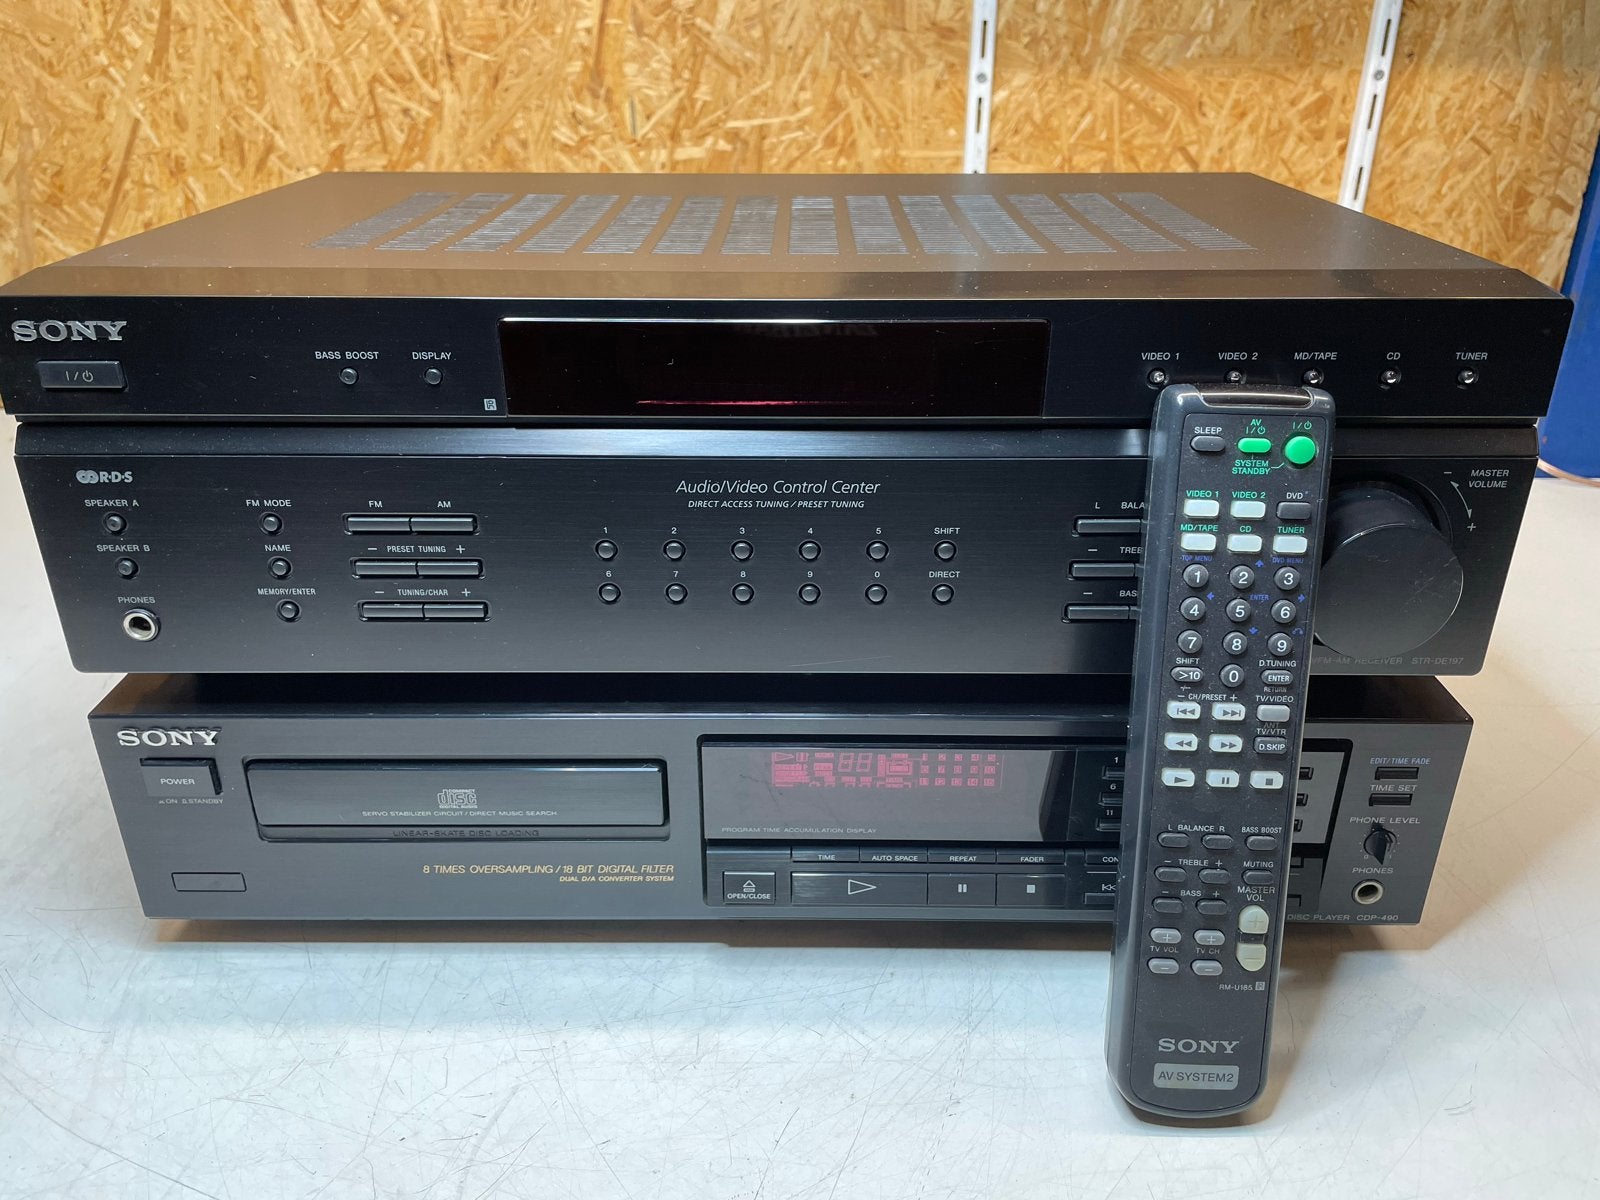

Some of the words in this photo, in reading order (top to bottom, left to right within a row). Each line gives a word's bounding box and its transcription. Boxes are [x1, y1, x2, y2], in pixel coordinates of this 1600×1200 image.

[11, 320, 127, 342] SONY
[315, 351, 341, 360] BASS
[345, 351, 379, 360] BOOST
[412, 352, 452, 360] DISPLAY
[1141, 352, 1171, 361] VIDEO
[1175, 352, 1180, 360] 1
[1218, 352, 1248, 361] VIDEO
[1251, 352, 1258, 360] 2
[1294, 352, 1338, 361] MD/TAPE
[1386, 352, 1401, 360] CD
[1455, 352, 1488, 360] TUNER
[1470, 469, 1509, 477] MASTER
[675, 480, 768, 494] Audio/Video
[773, 480, 828, 494] Control
[831, 480, 881, 494] Center
[246, 499, 260, 507] FM
[264, 499, 292, 507] MODE
[368, 500, 383, 508] FM
[437, 500, 452, 508] AM
[688, 500, 719, 508] DIRECT
[721, 500, 753, 508] ACCESS
[755, 500, 789, 508] TUNING
[797, 500, 829, 508] PRESET
[830, 500, 865, 508] TUNING
[934, 527, 960, 535] SHIFT
[1180, 524, 1219, 532] MD/TAPE
[264, 544, 292, 552] NAME
[386, 545, 415, 553] PRESET
[418, 545, 447, 553] TUNING
[605, 570, 612, 578] 6
[673, 570, 679, 578] 7
[740, 570, 746, 578] 8
[807, 570, 813, 578] 9
[874, 570, 880, 578] 0
[928, 570, 960, 578] DIRECT
[1194, 571, 1201, 583] 1
[1238, 571, 1249, 584] 2
[1283, 572, 1294, 585] 3
[117, 596, 156, 604] PHONES
[1189, 604, 1200, 616] 4
[1235, 605, 1245, 618] 5
[1280, 606, 1291, 619] 6
[1187, 637, 1197, 649] 7
[1231, 638, 1242, 651] 8
[1277, 640, 1287, 652] 9
[1411, 657, 1464, 665] STR-DE197
[1229, 671, 1239, 683] 0
[117, 729, 218, 747] SONY
[1259, 743, 1286, 751] D.SKIP
[1370, 757, 1409, 765] EDIT/TIME
[1411, 757, 1431, 765] FADE
[1177, 824, 1215, 832] BALANCE
[1219, 825, 1226, 833] R
[1261, 826, 1283, 834] BOOST
[423, 865, 430, 873] 8
[434, 865, 466, 873] TIMES
[469, 865, 554, 874] OVERSAMPLING
[577, 865, 594, 873] BIT
[598, 865, 638, 873] DIGITAL
[641, 864, 674, 873] FILTER
[1237, 886, 1275, 894] MASTER
[1246, 894, 1265, 902] VOL
[1158, 1038, 1240, 1054] SONY
[1158, 1071, 1174, 1081] AV
[1176, 1073, 1234, 1082] SYSTEM2
